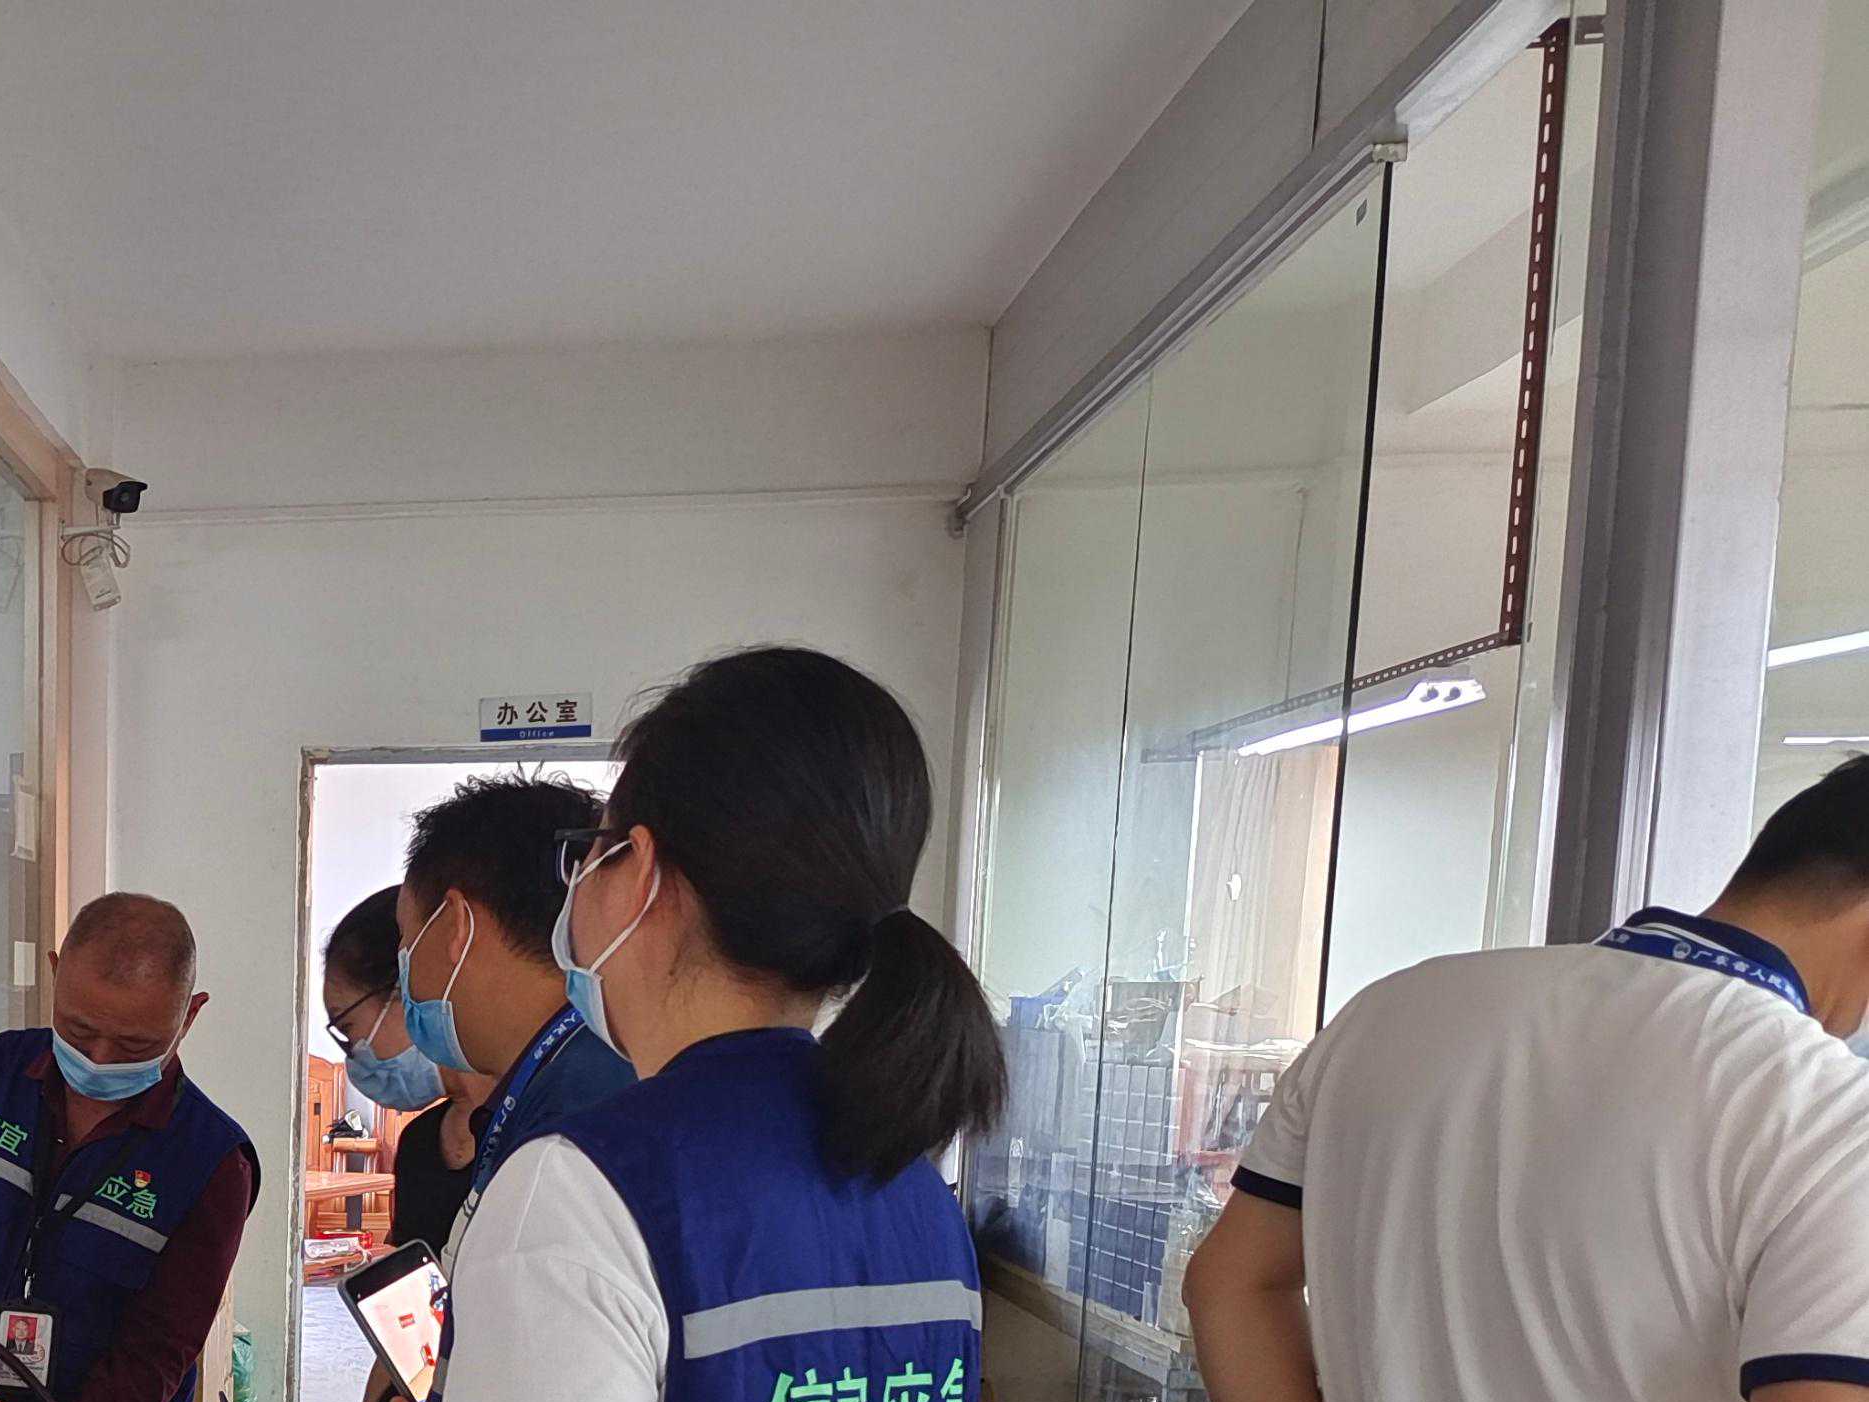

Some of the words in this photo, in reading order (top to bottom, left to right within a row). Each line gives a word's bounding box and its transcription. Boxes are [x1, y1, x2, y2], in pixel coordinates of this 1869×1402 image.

[496, 700, 578, 725] 办公室
[519, 730, 555, 739] Office
[96, 1175, 158, 1219] 应急
